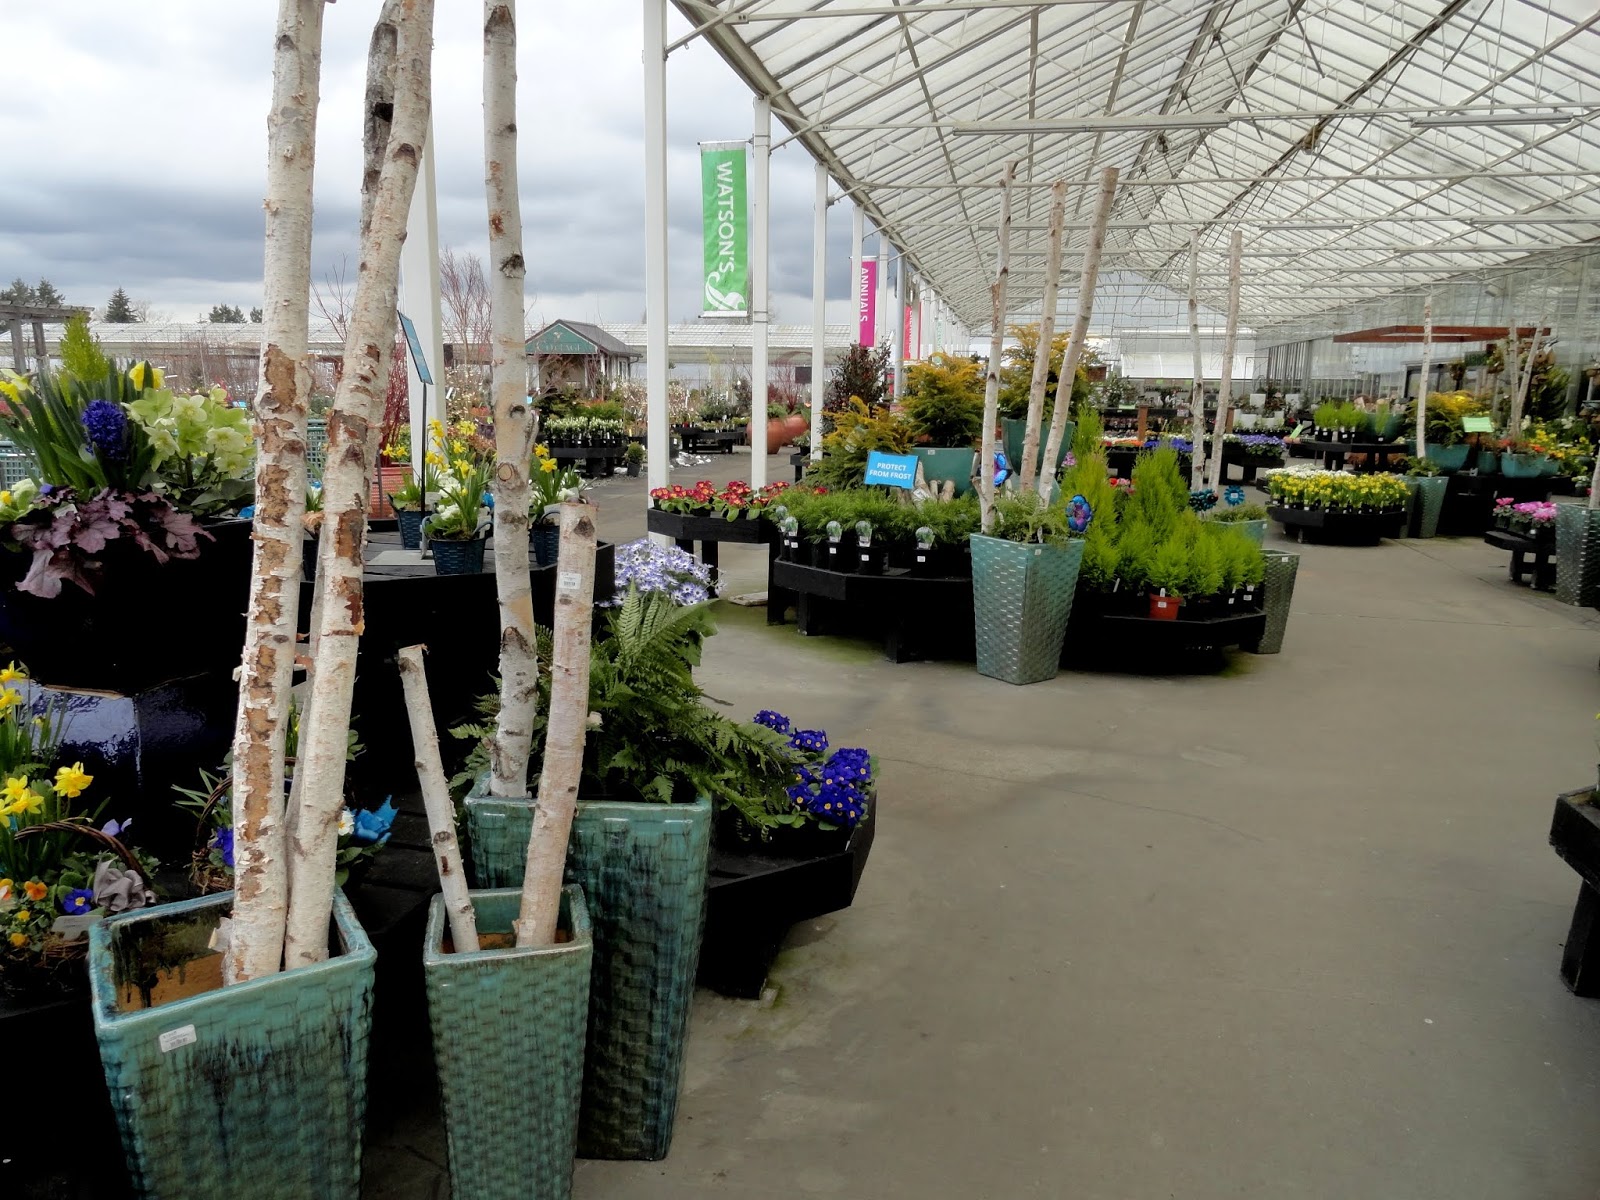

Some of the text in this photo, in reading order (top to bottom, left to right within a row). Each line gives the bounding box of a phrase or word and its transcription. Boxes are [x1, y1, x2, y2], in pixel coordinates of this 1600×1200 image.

[716, 161, 735, 273] WATSON'S
[860, 267, 869, 322] ANNUALS
[869, 469, 912, 480] FROM FROST
[877, 462, 907, 471] PROTECT
